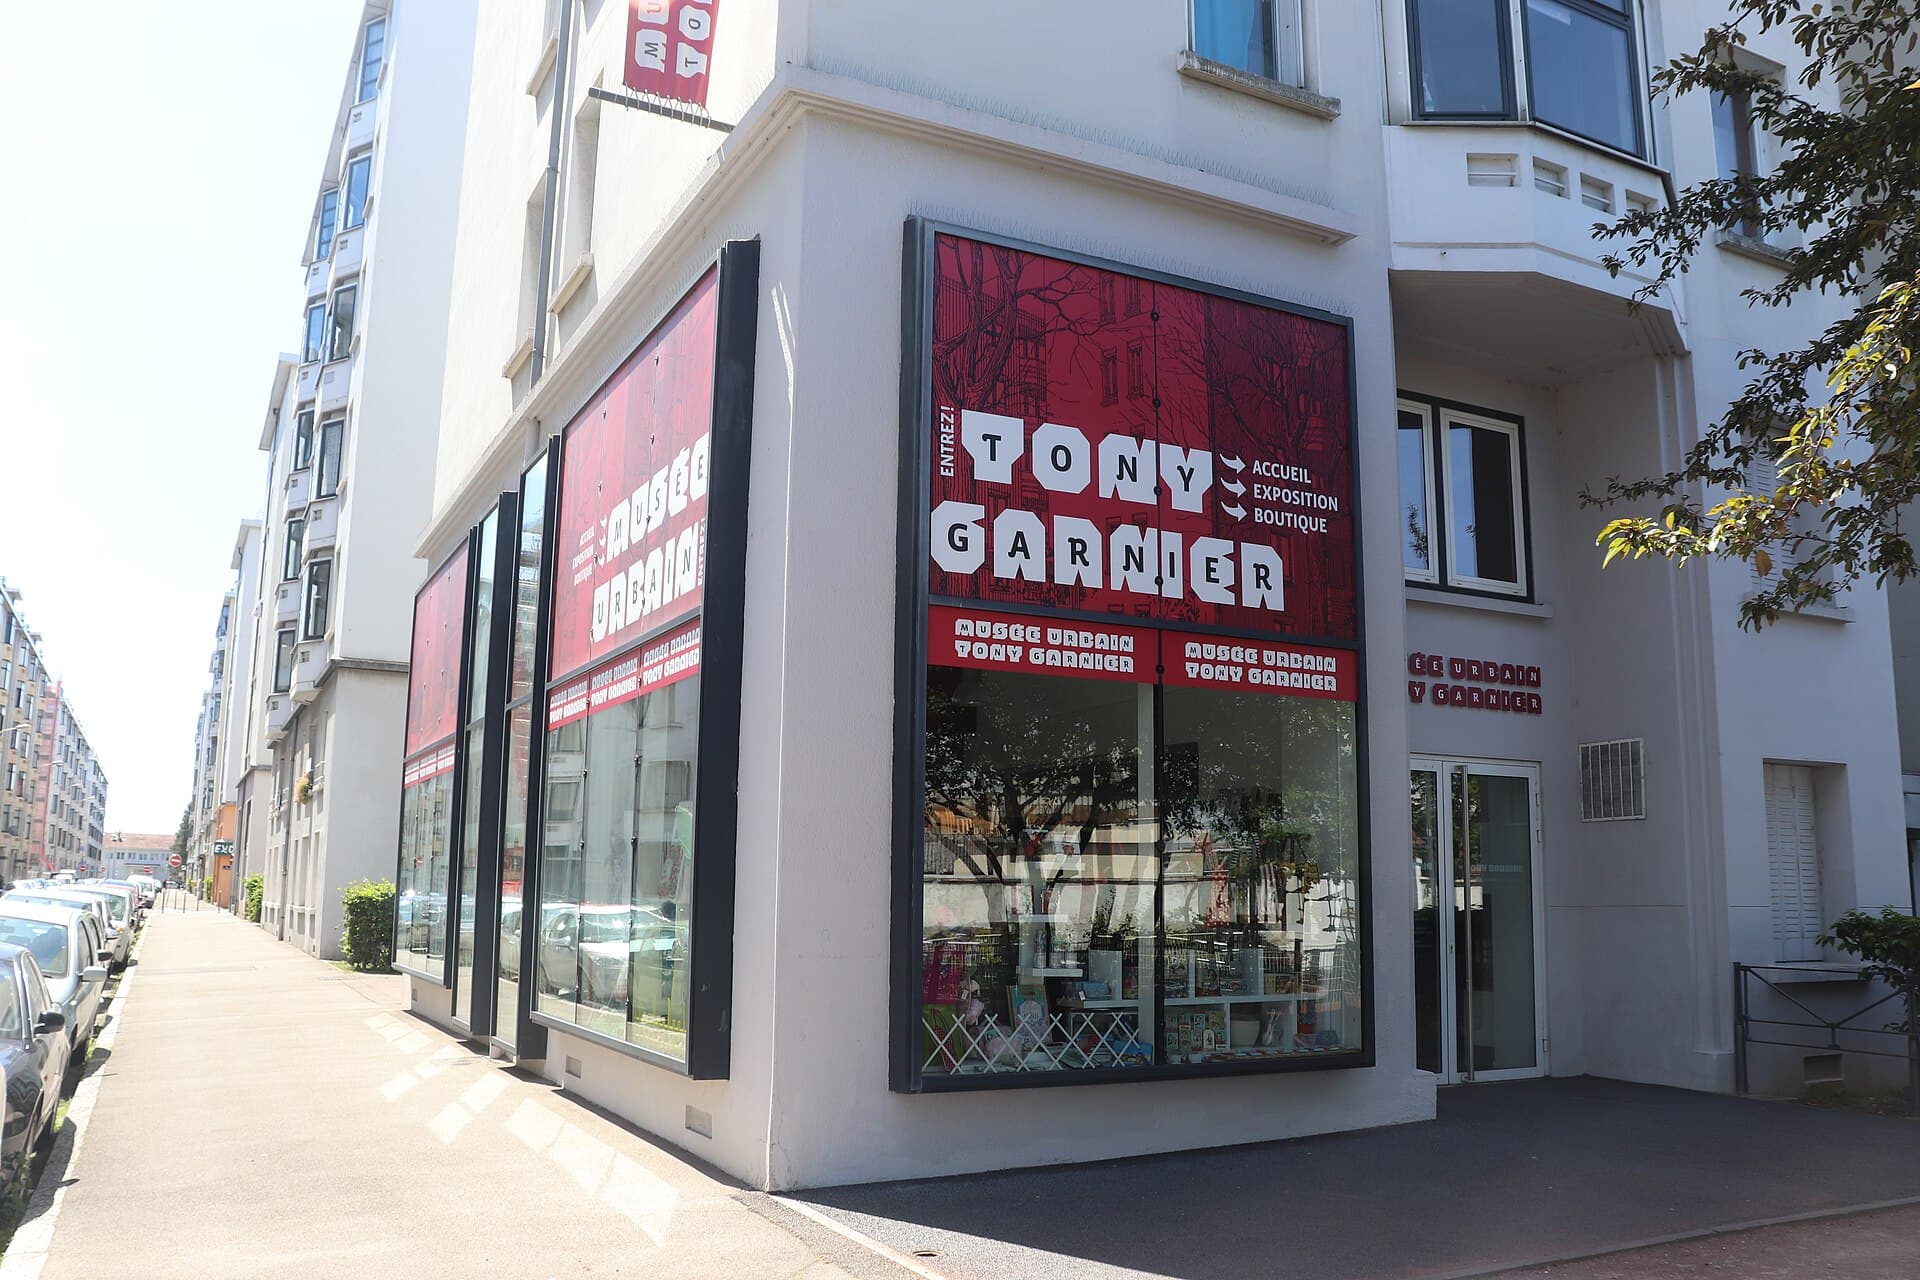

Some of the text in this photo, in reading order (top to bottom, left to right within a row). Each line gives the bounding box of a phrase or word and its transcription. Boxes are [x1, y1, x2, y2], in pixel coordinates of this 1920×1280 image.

[940, 405, 955, 477] ENTREZ!
[961, 408, 1213, 514] TONY
[1252, 459, 1312, 484] ACCUEIL
[606, 432, 710, 565] MUSÉE
[1253, 483, 1338, 512] EXPOSITION
[1254, 507, 1328, 534] BOUTIQUE
[930, 500, 1285, 612] GARNIER
[592, 521, 700, 643] URBAIN
[955, 618, 1134, 652] MUSÉE URBAIN
[955, 640, 1134, 672] TONY GARNIER
[1185, 642, 1336, 672] MUSÉE URBAIN
[1450, 657, 1541, 688] URBAIN
[1185, 662, 1337, 691] TONY GARNIER
[1408, 680, 1542, 715] Y GARNIER
